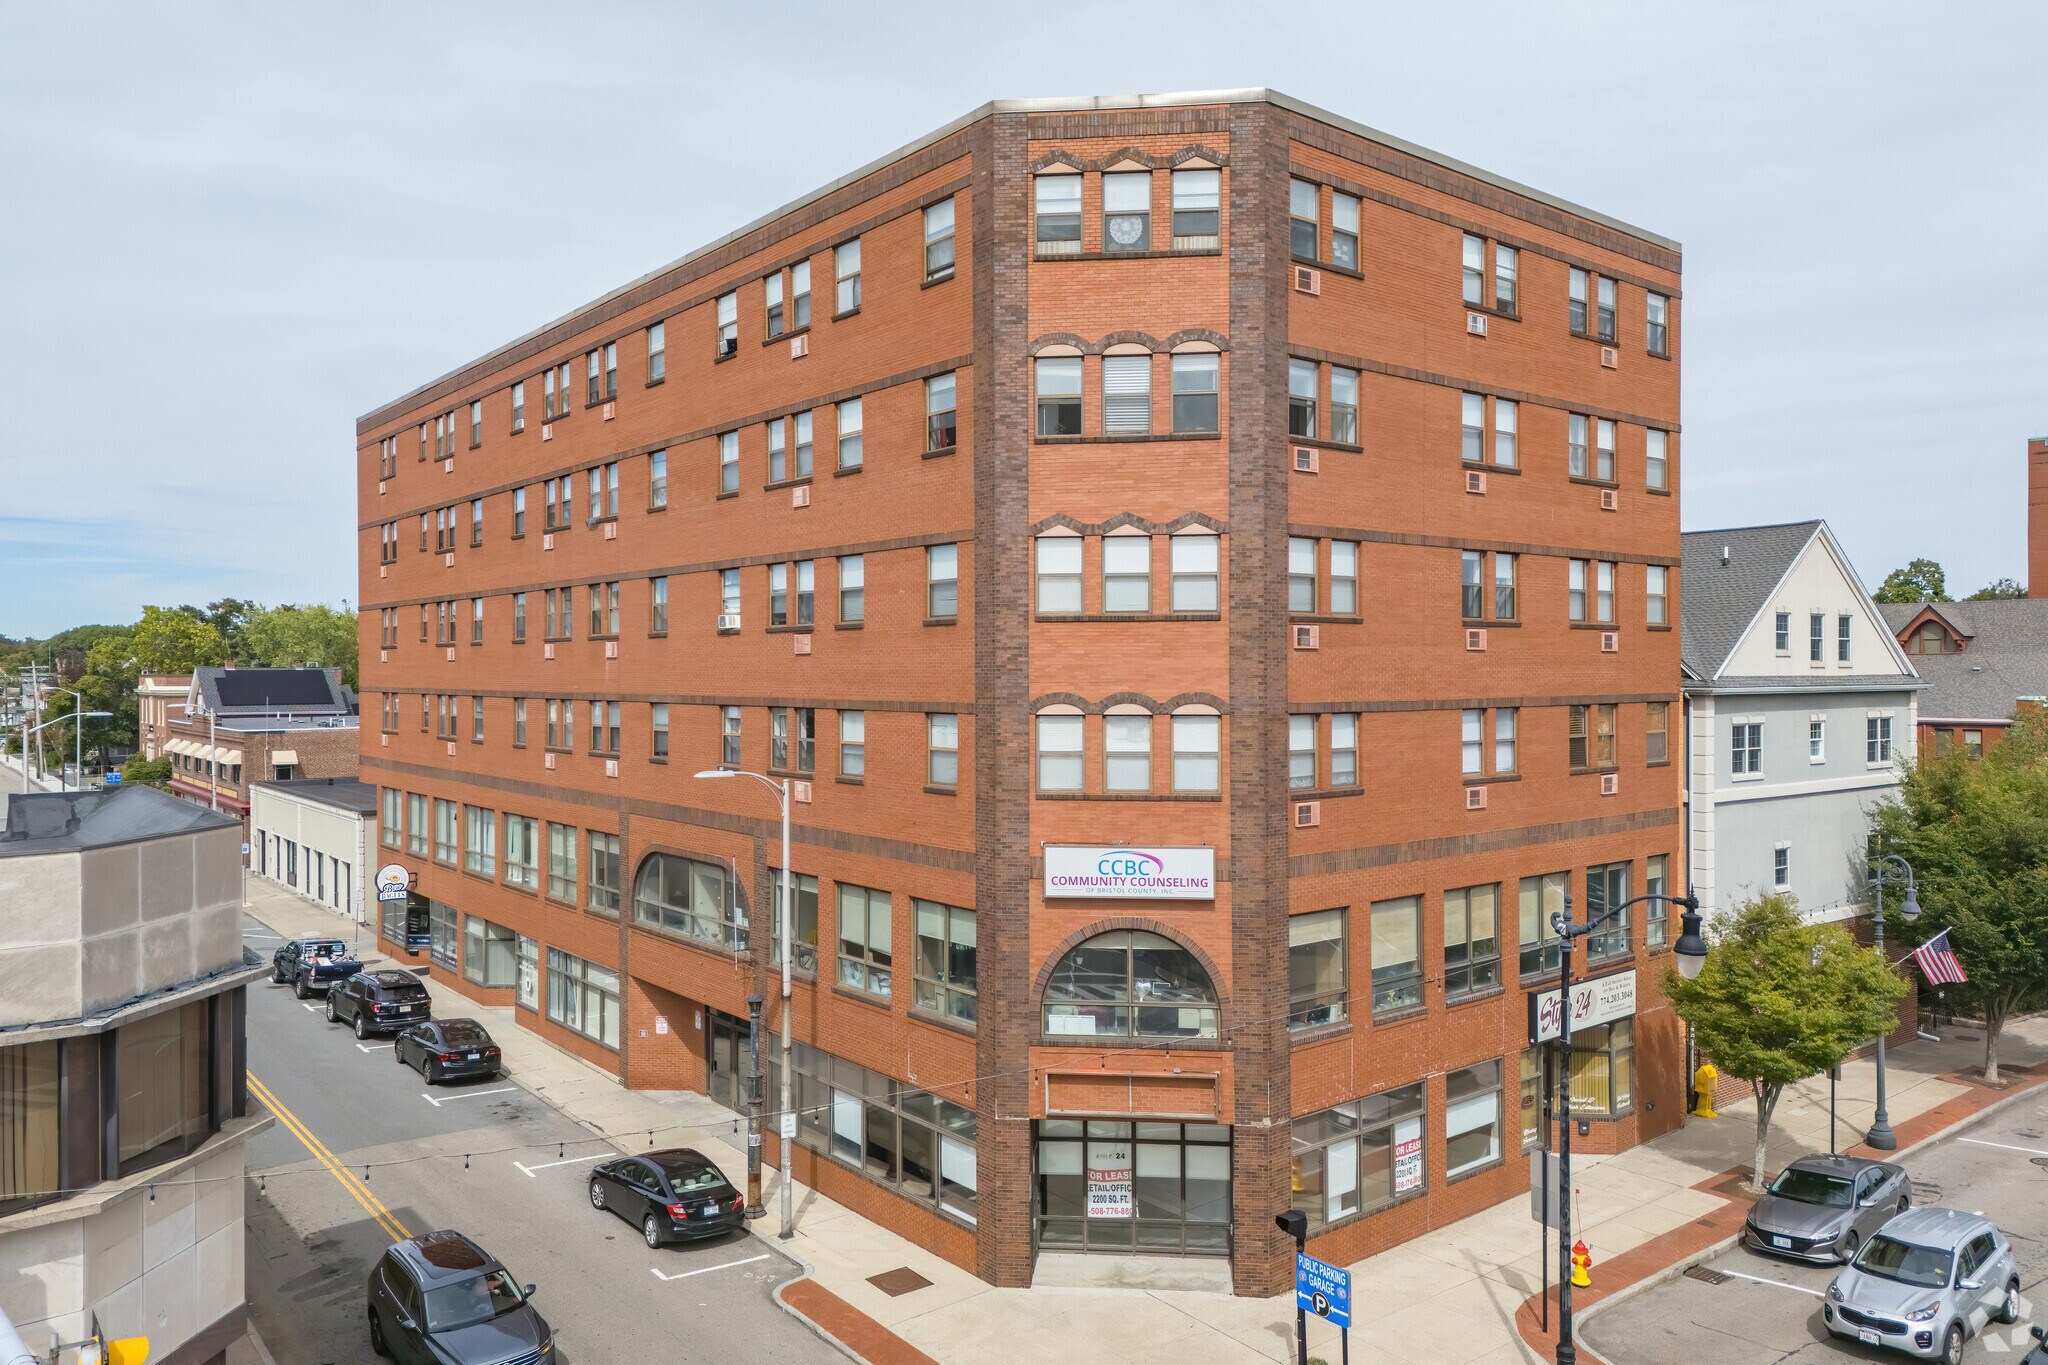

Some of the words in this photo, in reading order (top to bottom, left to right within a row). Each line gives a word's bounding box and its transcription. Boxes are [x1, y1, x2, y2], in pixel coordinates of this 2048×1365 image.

[1098, 859, 1150, 876] CCBC
[1051, 876, 1127, 887] COMMUNITY
[1130, 877, 1209, 888] COUNSELING
[1541, 997, 1572, 1033] Sty
[1575, 989, 1592, 1020] 24
[1396, 1145, 1405, 1156] OR
[1088, 1184, 1132, 1192] ETAIL/OFFIC
[1093, 1195, 1107, 1203] 2200
[1108, 1195, 1119, 1204] SQ.
[1120, 1195, 1129, 1203] FT.
[1298, 1255, 1319, 1275] PUBLIC
[1319, 1264, 1346, 1286] PARKING
[1308, 1273, 1335, 1296] GARAGE
